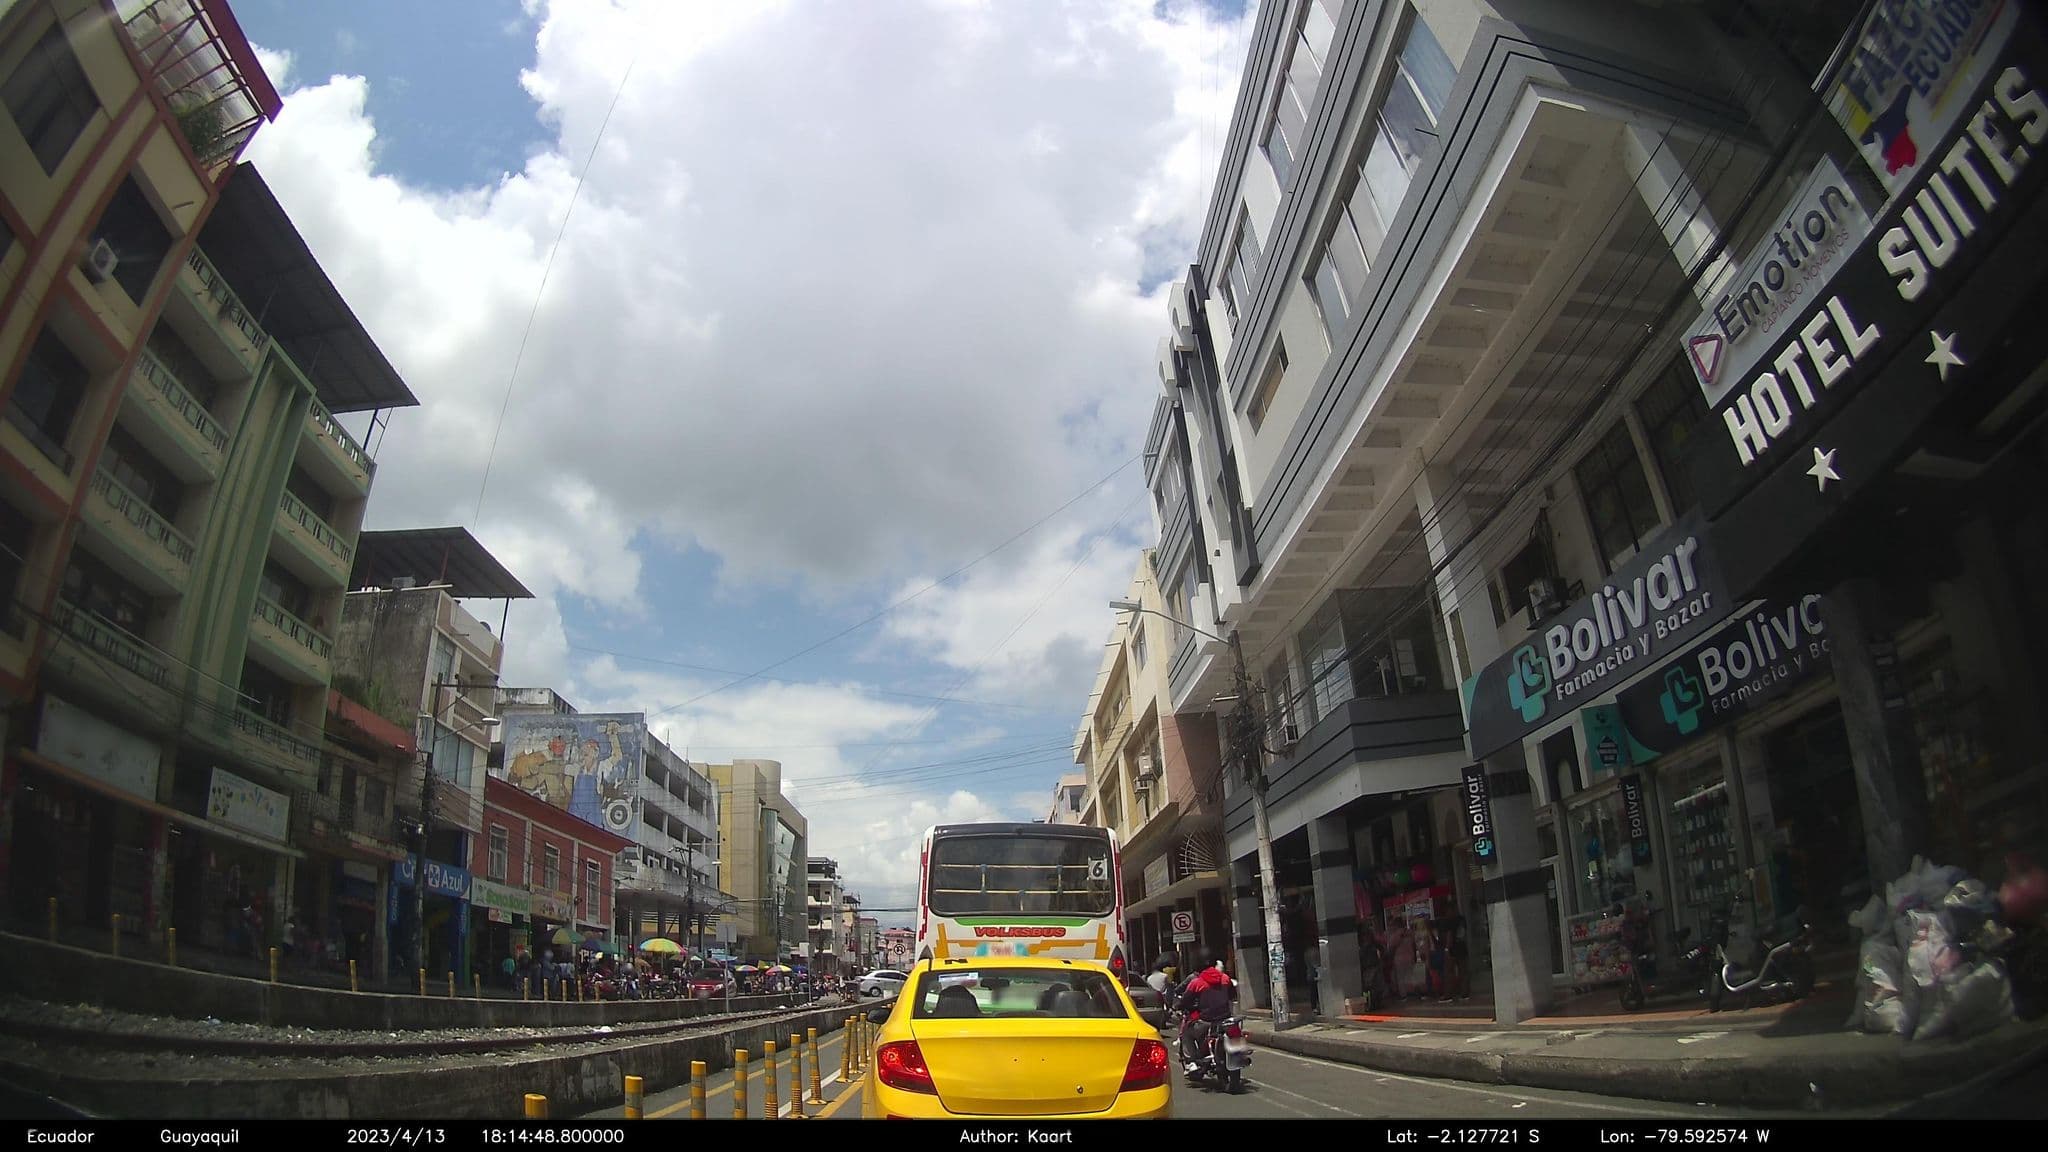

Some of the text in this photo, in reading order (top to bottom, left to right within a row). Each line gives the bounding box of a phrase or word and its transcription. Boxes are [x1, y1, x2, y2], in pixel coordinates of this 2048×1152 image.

[1713, 185, 1849, 344] Emotion
[1722, 66, 2048, 467] HOTEL SUITES
[1760, 231, 1849, 333] CAPTANDO MOMENTOS
[1545, 536, 1698, 681] Bolivar
[1555, 591, 1711, 701] Farmacia y Bazar
[1711, 664, 1788, 715] Farmacia
[1793, 654, 1802, 673] y
[1467, 775, 1486, 836] Bolivar
[1626, 784, 1642, 838] Bolivar
[440, 869, 463, 893] Azul
[1092, 861, 1104, 878] 6
[974, 926, 1067, 938] VOLKSBUS
